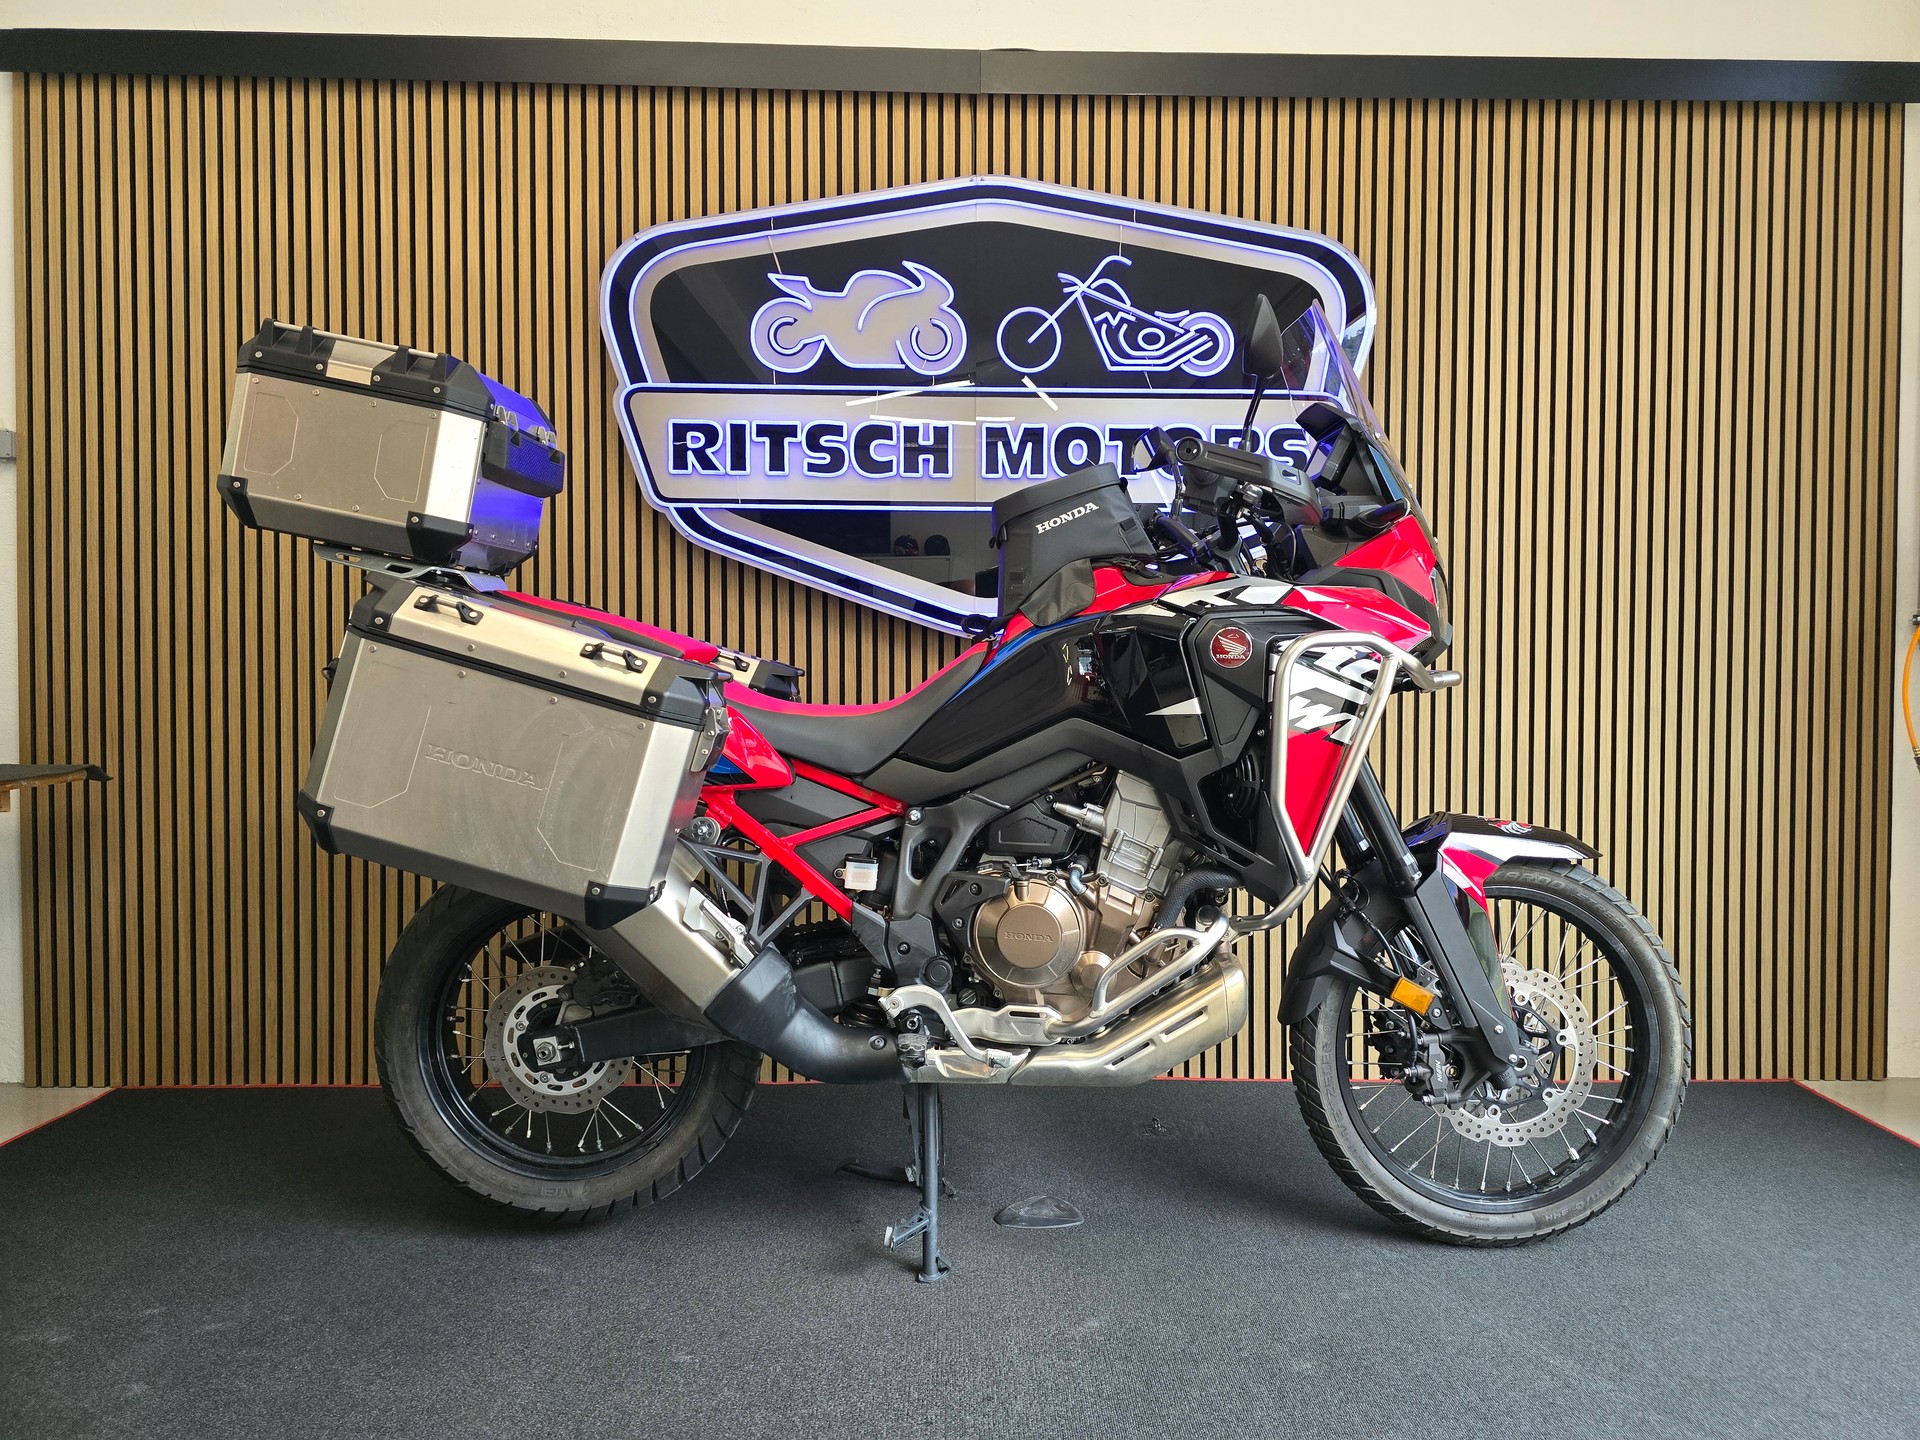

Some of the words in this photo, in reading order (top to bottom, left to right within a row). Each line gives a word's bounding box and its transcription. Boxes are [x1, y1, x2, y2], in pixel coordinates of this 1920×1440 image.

[668, 419, 953, 479] RITSCH
[1035, 502, 1099, 535] HONDA
[425, 743, 543, 791] HONDA
[1003, 931, 1054, 943] HONDA
